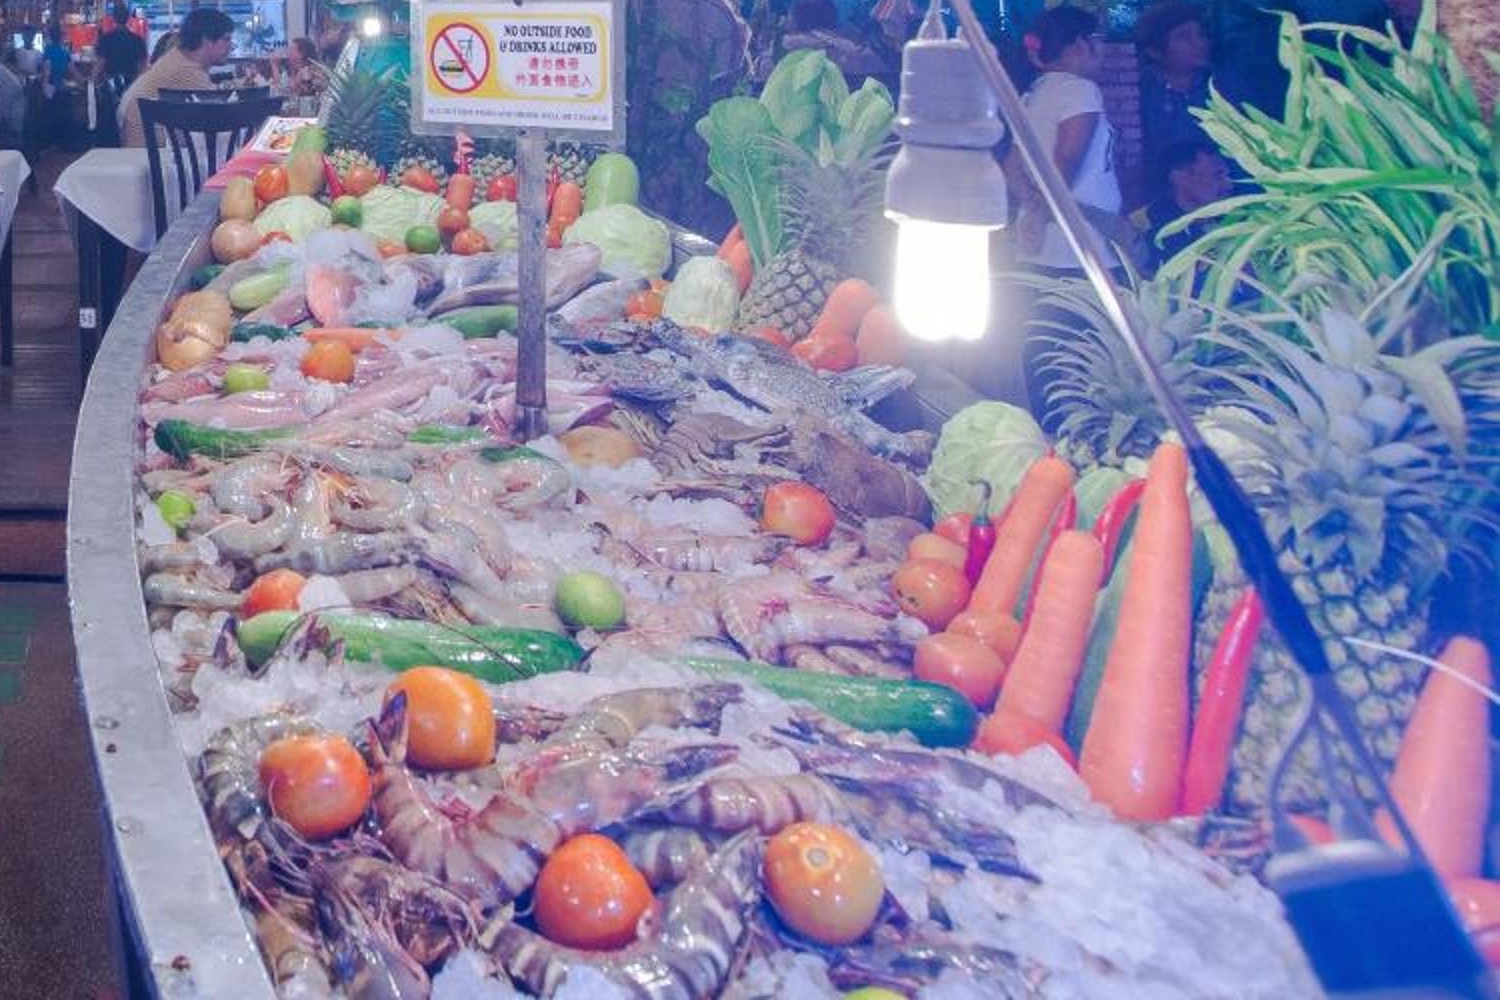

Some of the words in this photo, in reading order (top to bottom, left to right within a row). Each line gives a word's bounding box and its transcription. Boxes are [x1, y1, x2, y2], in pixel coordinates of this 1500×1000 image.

[503, 25, 519, 37] NO
[520, 25, 563, 38] OUTSIDE
[565, 26, 593, 39] FOOD
[509, 41, 547, 54] DRINKS
[548, 42, 598, 55] ALLOWED
